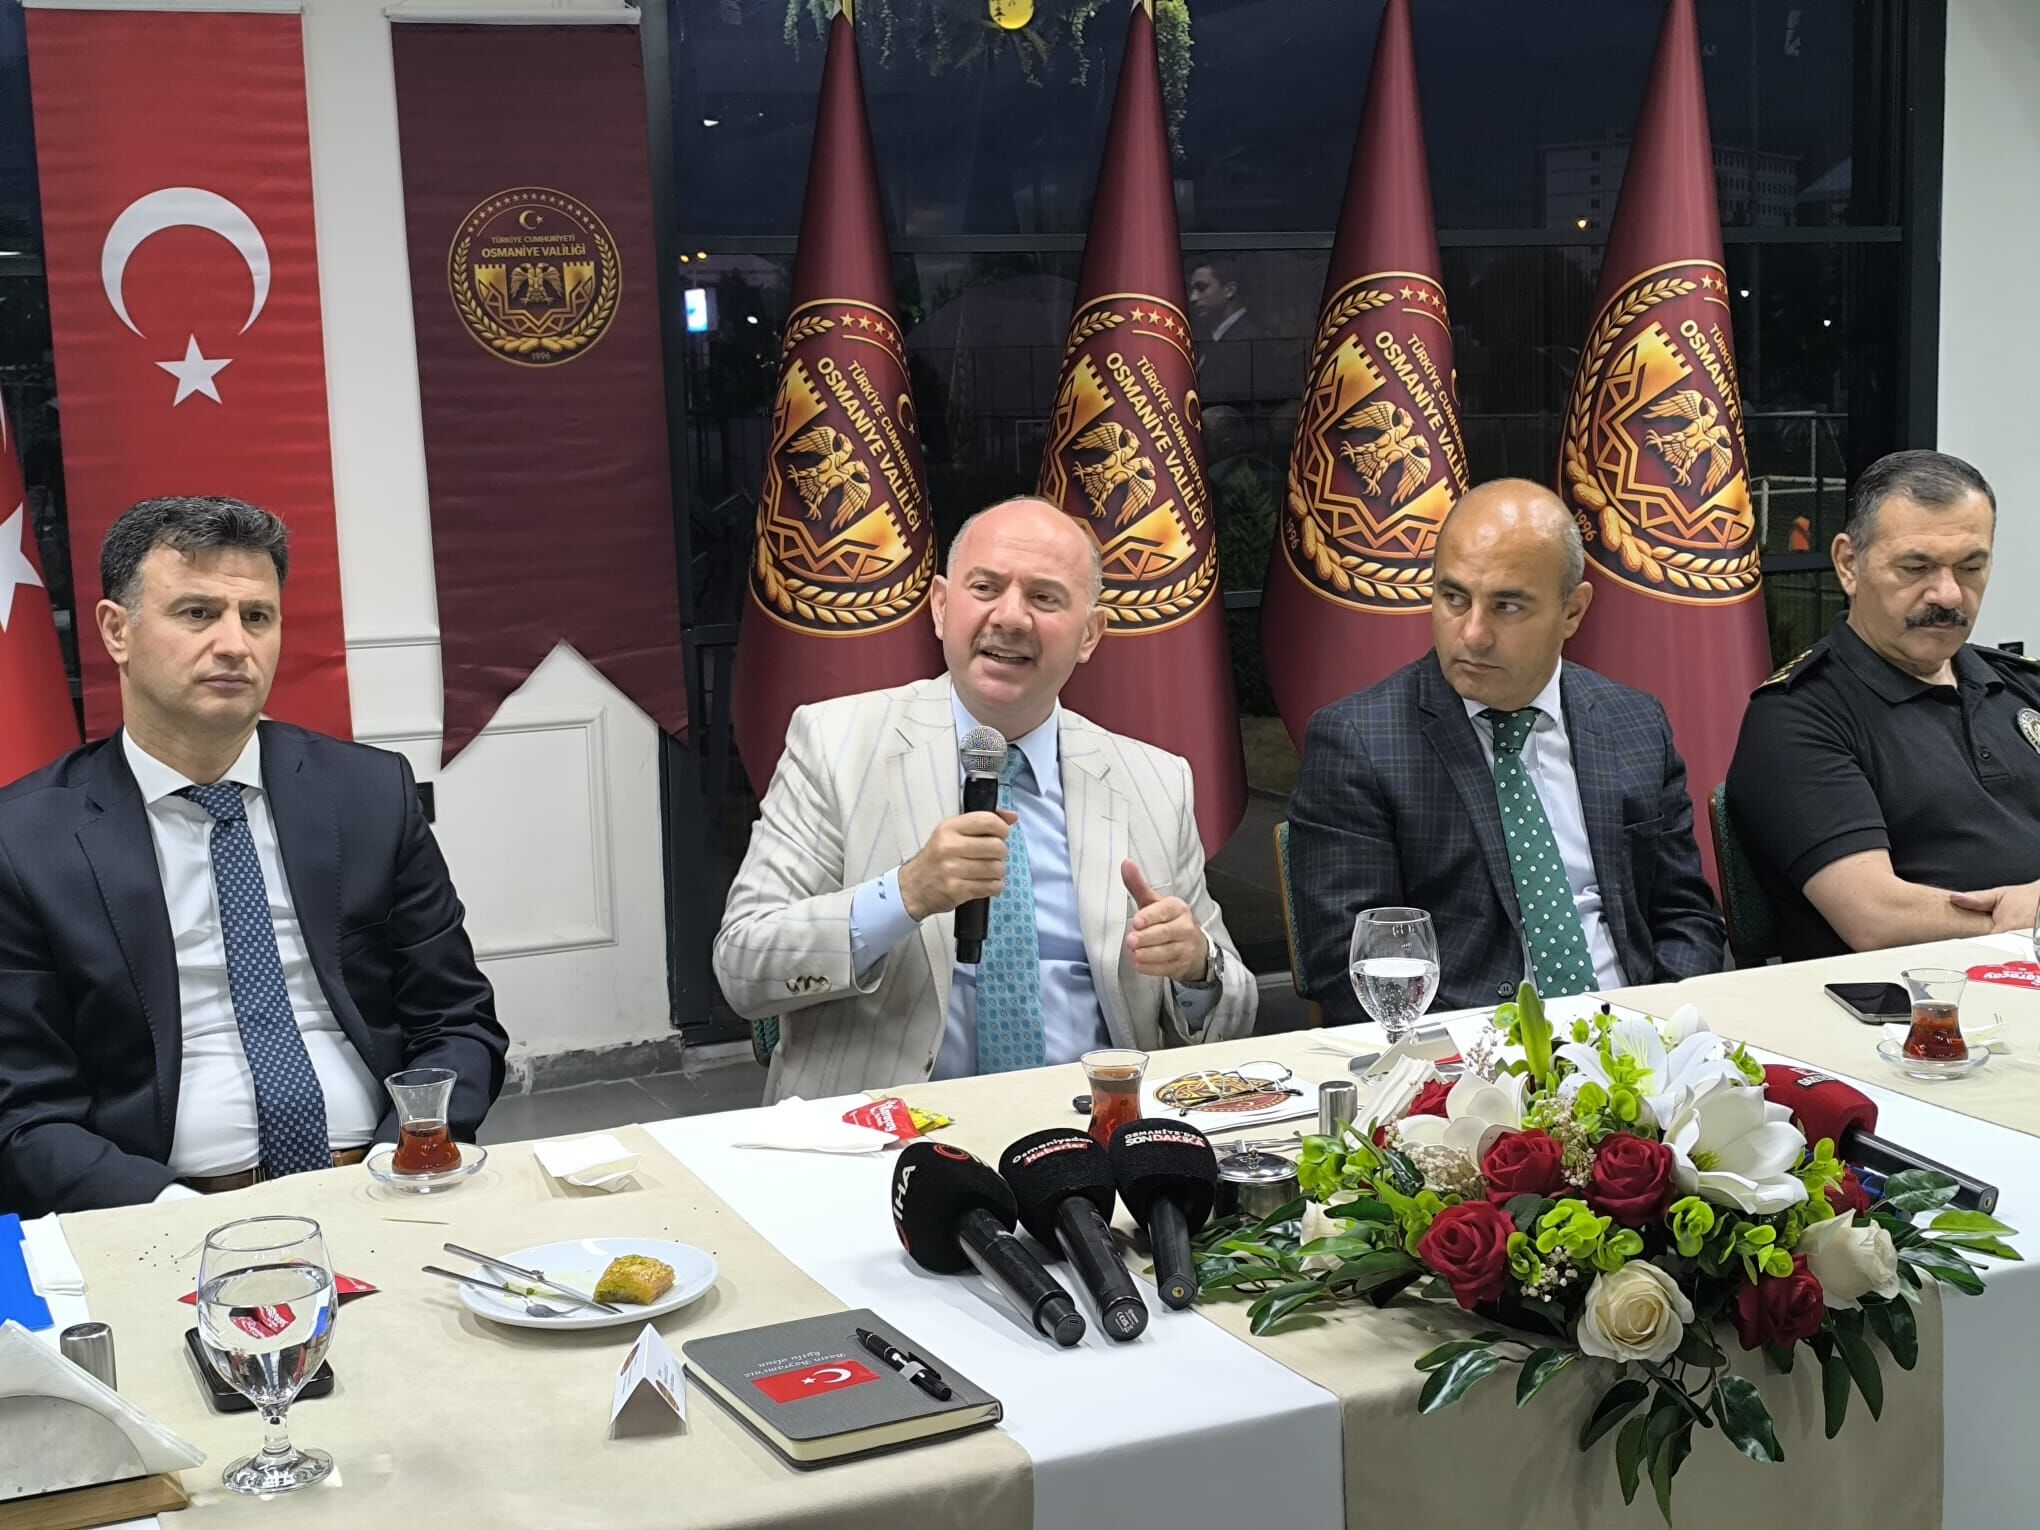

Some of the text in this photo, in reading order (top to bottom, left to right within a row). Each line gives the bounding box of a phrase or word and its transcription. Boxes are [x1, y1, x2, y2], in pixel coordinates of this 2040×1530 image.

[481, 242, 586, 259] OSMANİYE VALİLİĞİ
[491, 236, 523, 245] TÜRKİYE
[847, 359, 886, 417] TÜRKİYE
[1136, 355, 1173, 414] TÜRKİYE
[1375, 330, 1445, 432] OSMANİYE
[1407, 333, 1443, 392] TÜRKİYE
[1680, 319, 1739, 422] OSMANİYE
[817, 356, 886, 457] OSMANİYE
[1105, 352, 1173, 454] OSMANİYE
[878, 453, 922, 533] VALİLİĞİ
[880, 415, 923, 504] CUMHURİYETİ
[1165, 449, 1208, 531] VALİLİĞİ
[1167, 411, 1208, 502] CUMHURİYETİ
[1285, 516, 1300, 550] 1996
[1574, 508, 1598, 542] 1996
